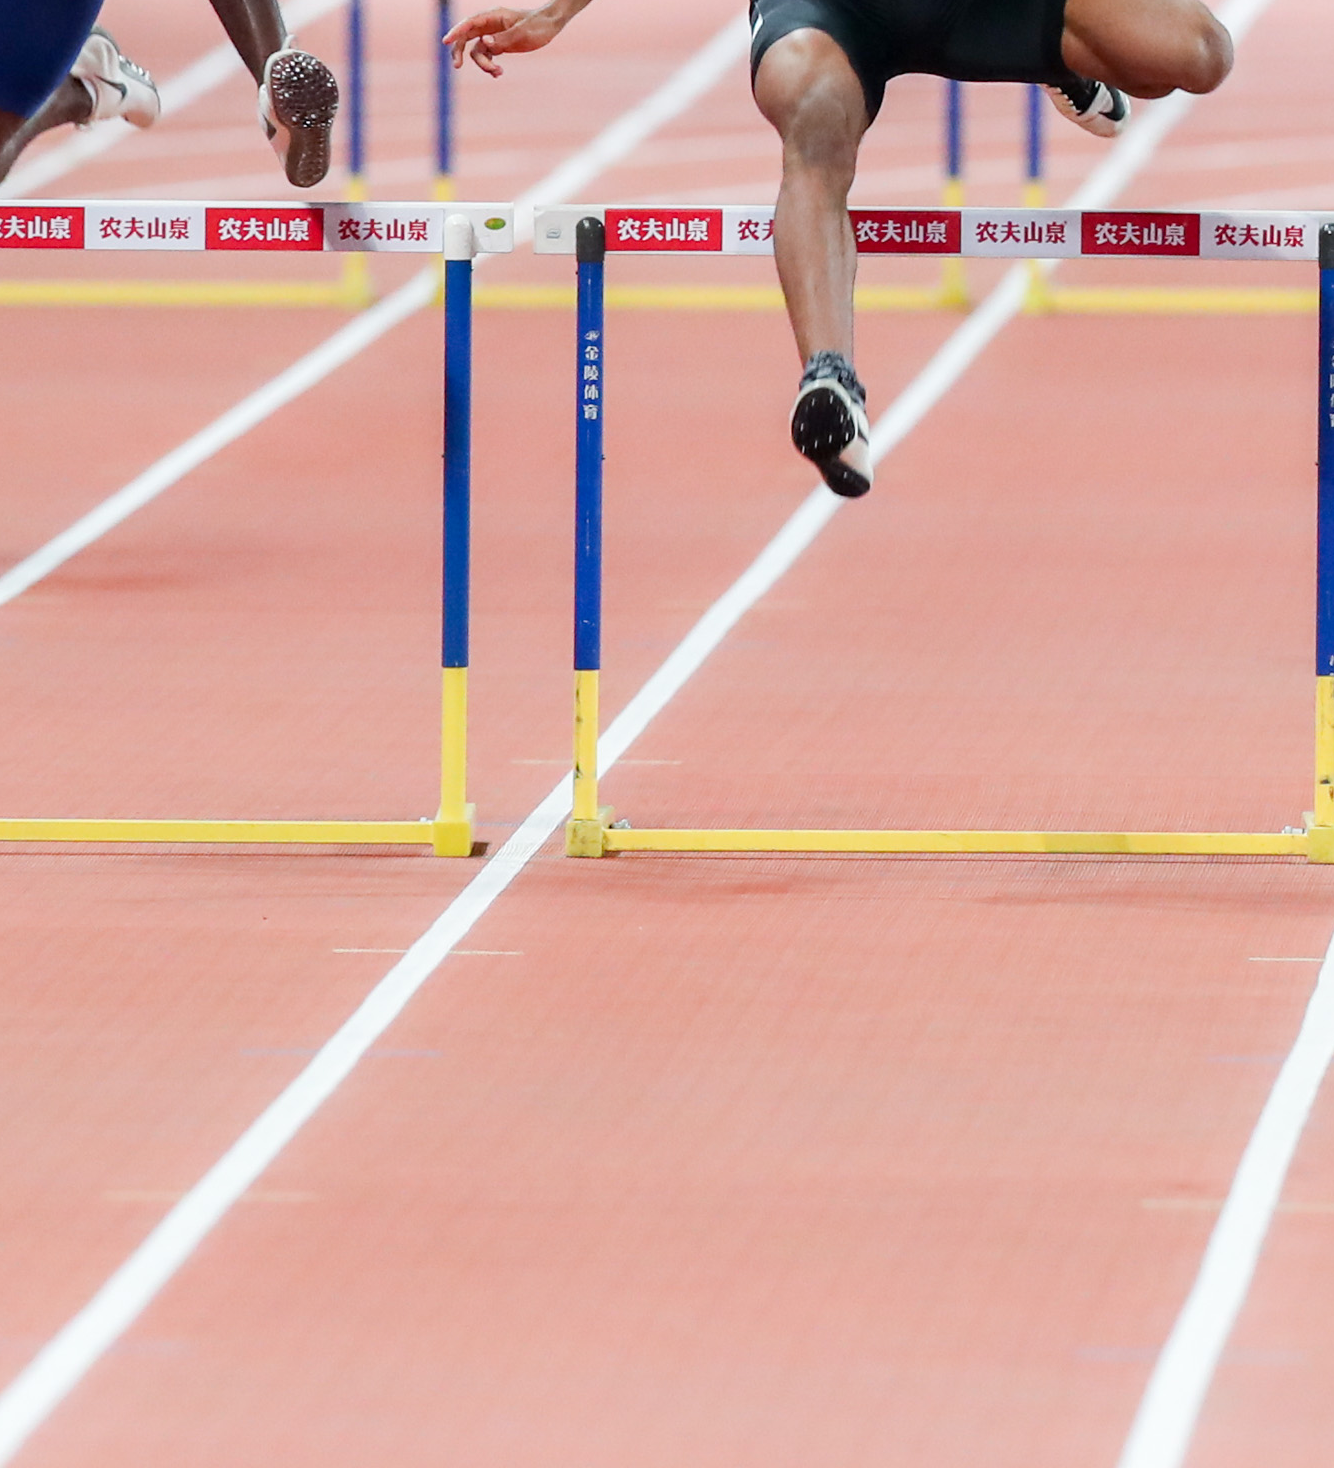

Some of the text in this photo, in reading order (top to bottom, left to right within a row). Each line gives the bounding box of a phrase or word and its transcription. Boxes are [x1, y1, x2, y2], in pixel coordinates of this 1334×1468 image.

[100, 218, 189, 239] 农夫山泉
[219, 217, 309, 242] 农夫山泉
[337, 219, 428, 241] 农夫山泉
[618, 217, 709, 242] 农夫山泉
[856, 219, 947, 244] 农夫山泉
[976, 221, 1066, 243] 农夫山泉
[1095, 221, 1185, 246] 农夫山泉
[1214, 224, 1305, 247] 农夫山泉
